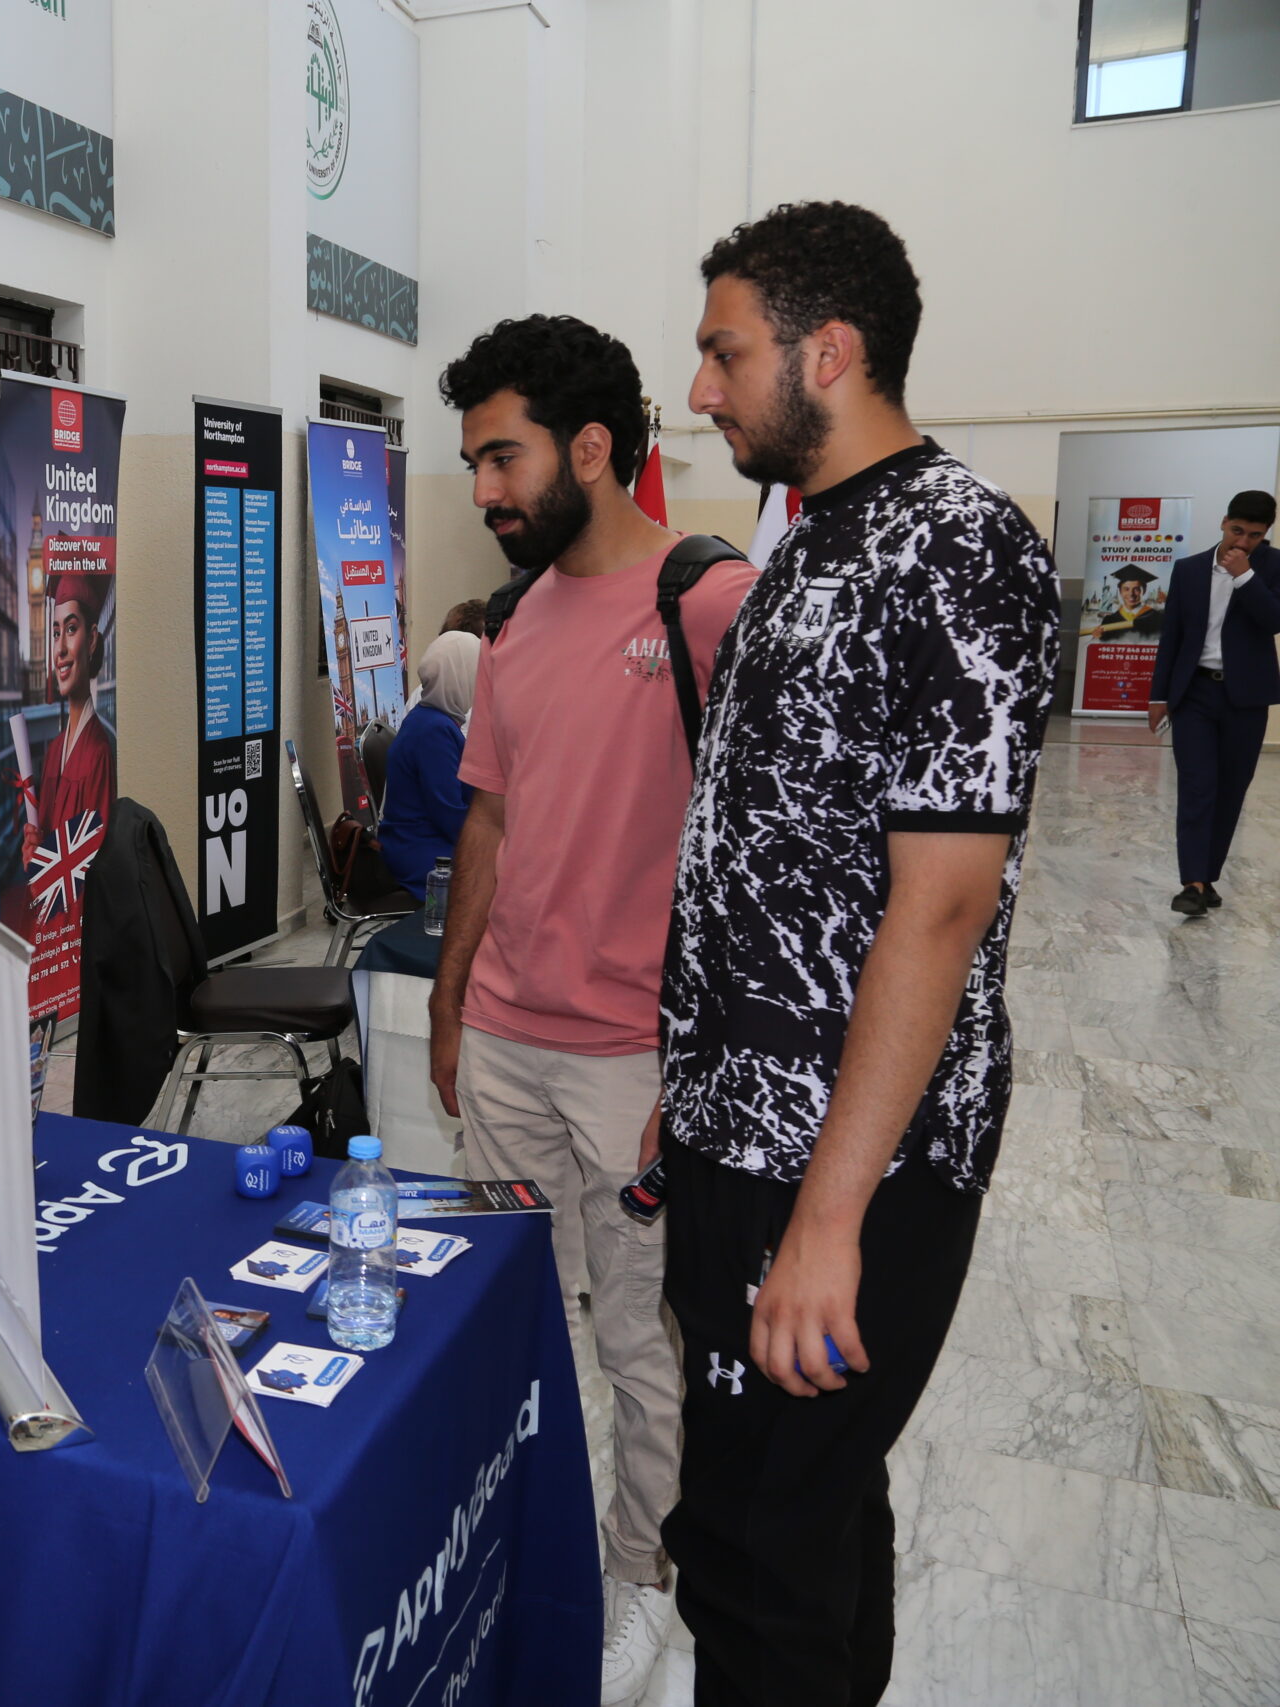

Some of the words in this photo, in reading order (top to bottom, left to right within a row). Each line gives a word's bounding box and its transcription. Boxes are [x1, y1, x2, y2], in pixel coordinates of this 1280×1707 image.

[204, 417, 234, 432] University
[235, 422, 242, 431] of
[54, 429, 80, 441] BRIDGE
[204, 430, 245, 444] Northampton
[206, 464, 246, 474] northampton.ac.uk
[342, 460, 363, 471] BRIDGE
[46, 463, 96, 493] United
[47, 494, 114, 531] Kingdom
[340, 498, 348, 517] في
[349, 499, 371, 515] الدراسة
[1121, 517, 1156, 525] BRIDGE
[337, 519, 381, 544] بريطانيا
[49, 538, 80, 552] Discover
[82, 539, 100, 552] Your
[49, 558, 72, 571] Future
[74, 558, 81, 570] in
[83, 558, 95, 571] the
[97, 558, 106, 570] UK
[345, 564, 369, 580] المستقبل
[371, 566, 382, 582] هي
[363, 630, 379, 642] UNITED
[363, 644, 382, 657] KINGDOM
[623, 638, 670, 660] AMI
[206, 788, 248, 832] UO
[206, 830, 246, 916] N
